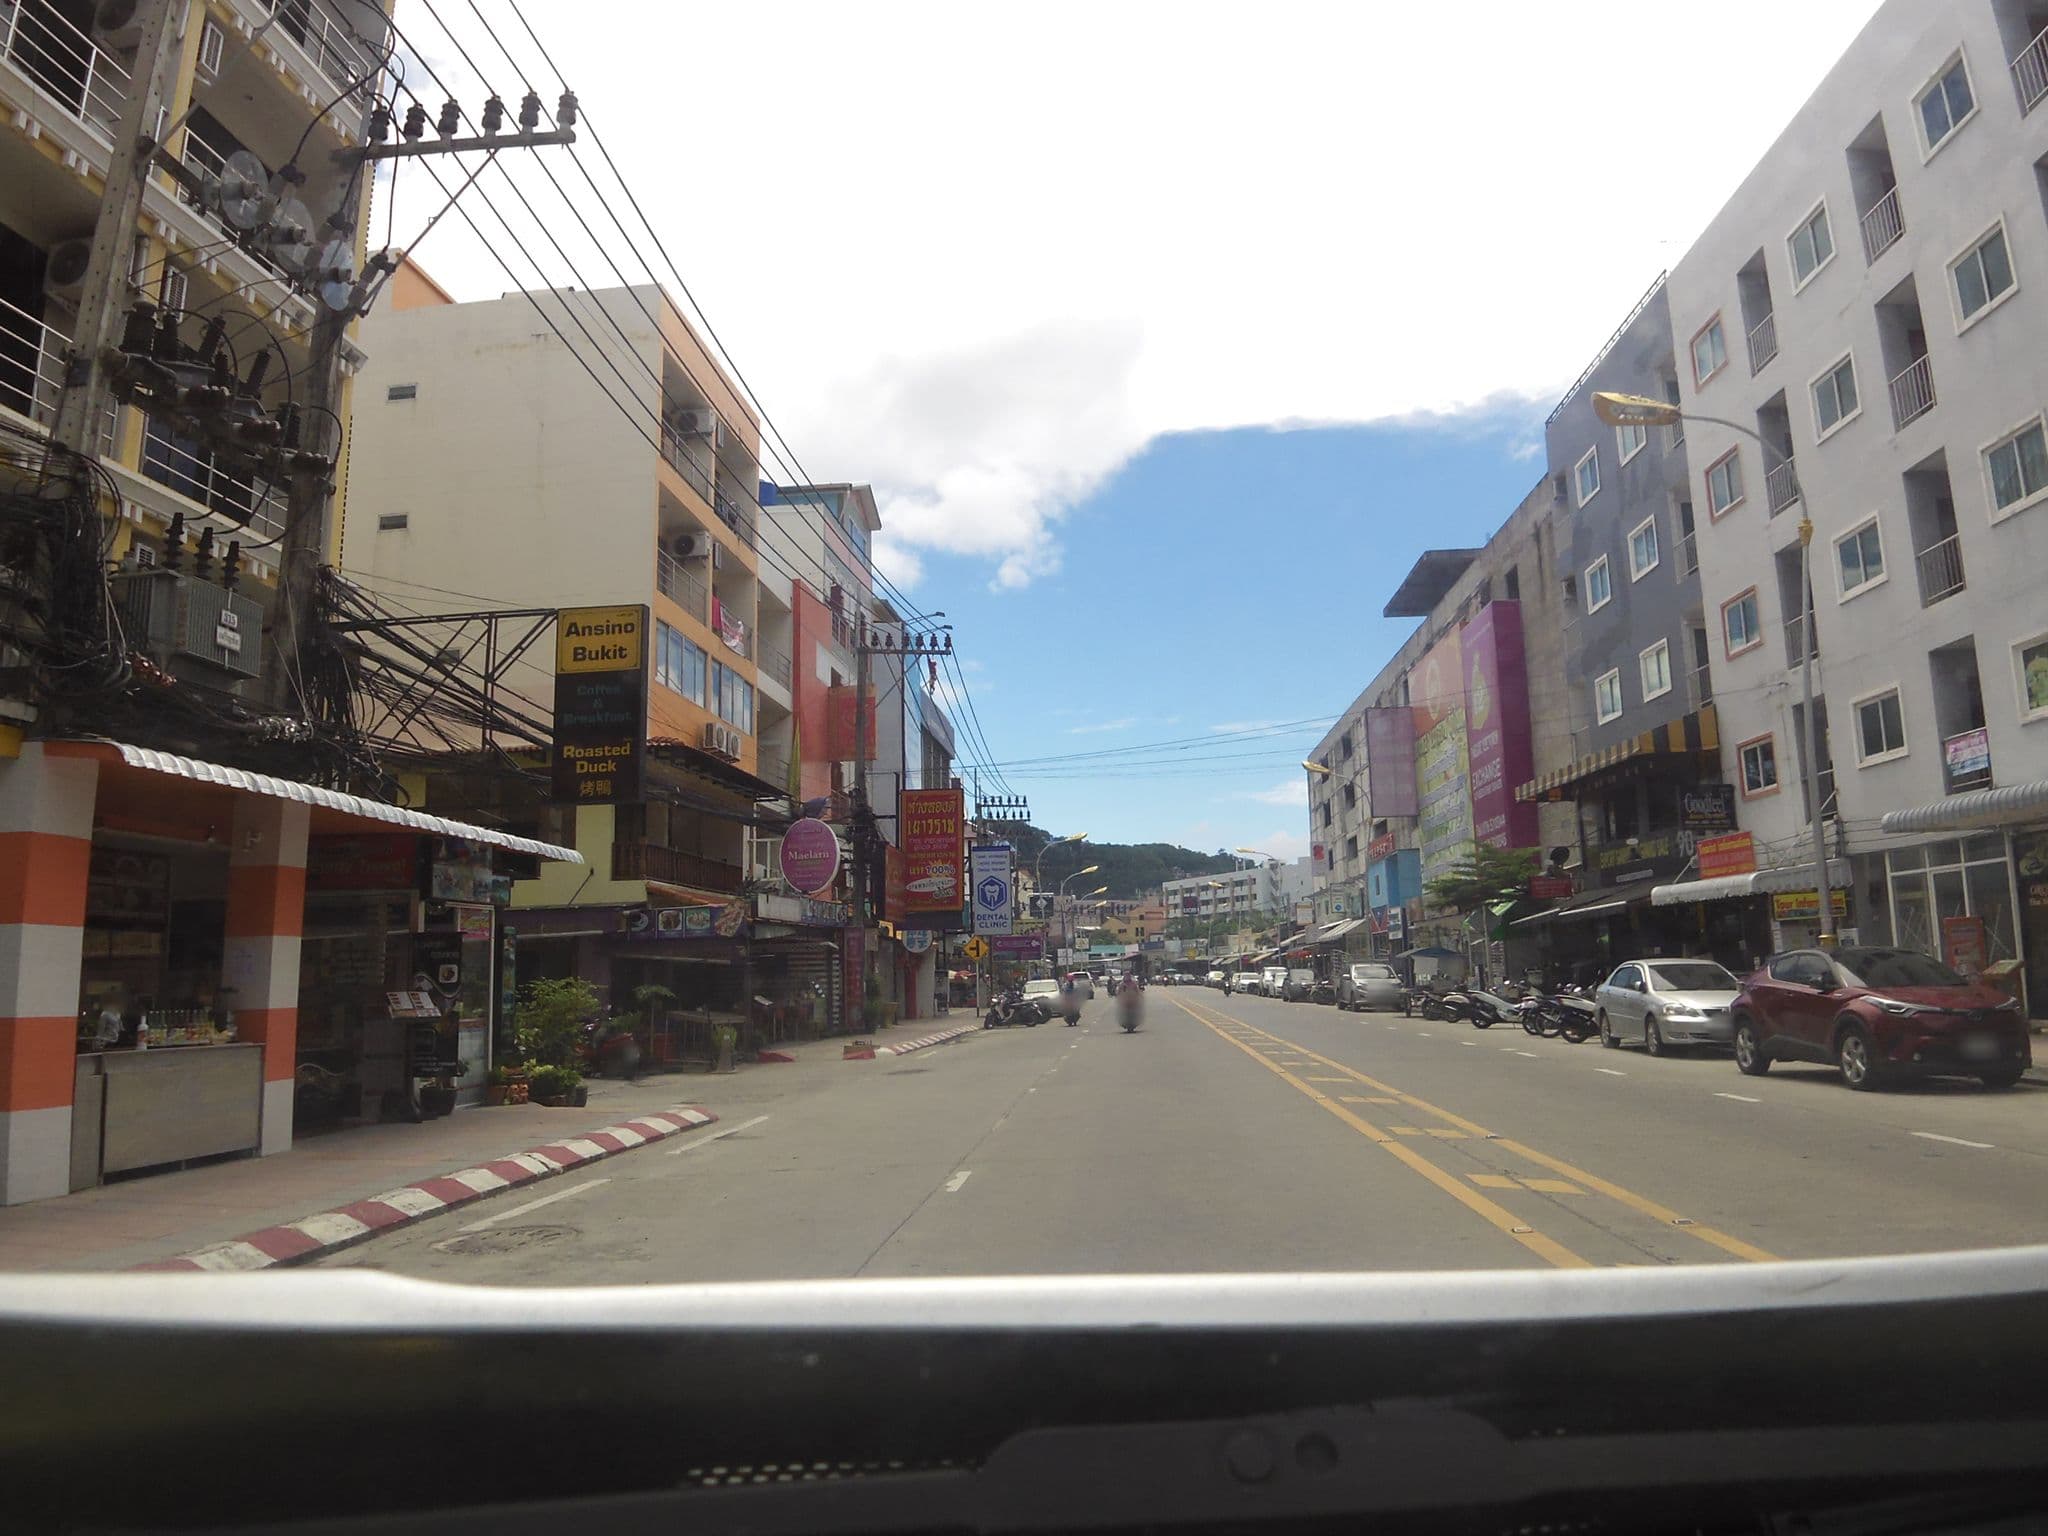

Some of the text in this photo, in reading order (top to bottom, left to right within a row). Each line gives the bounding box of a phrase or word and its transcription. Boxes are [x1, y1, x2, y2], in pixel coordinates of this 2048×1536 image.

[565, 620, 635, 638] Ansino
[573, 644, 628, 662] Bukit
[563, 743, 631, 759] Roasted
[576, 759, 617, 774] Duck
[926, 864, 956, 876] 100%
[979, 921, 1008, 929] CLINIC
